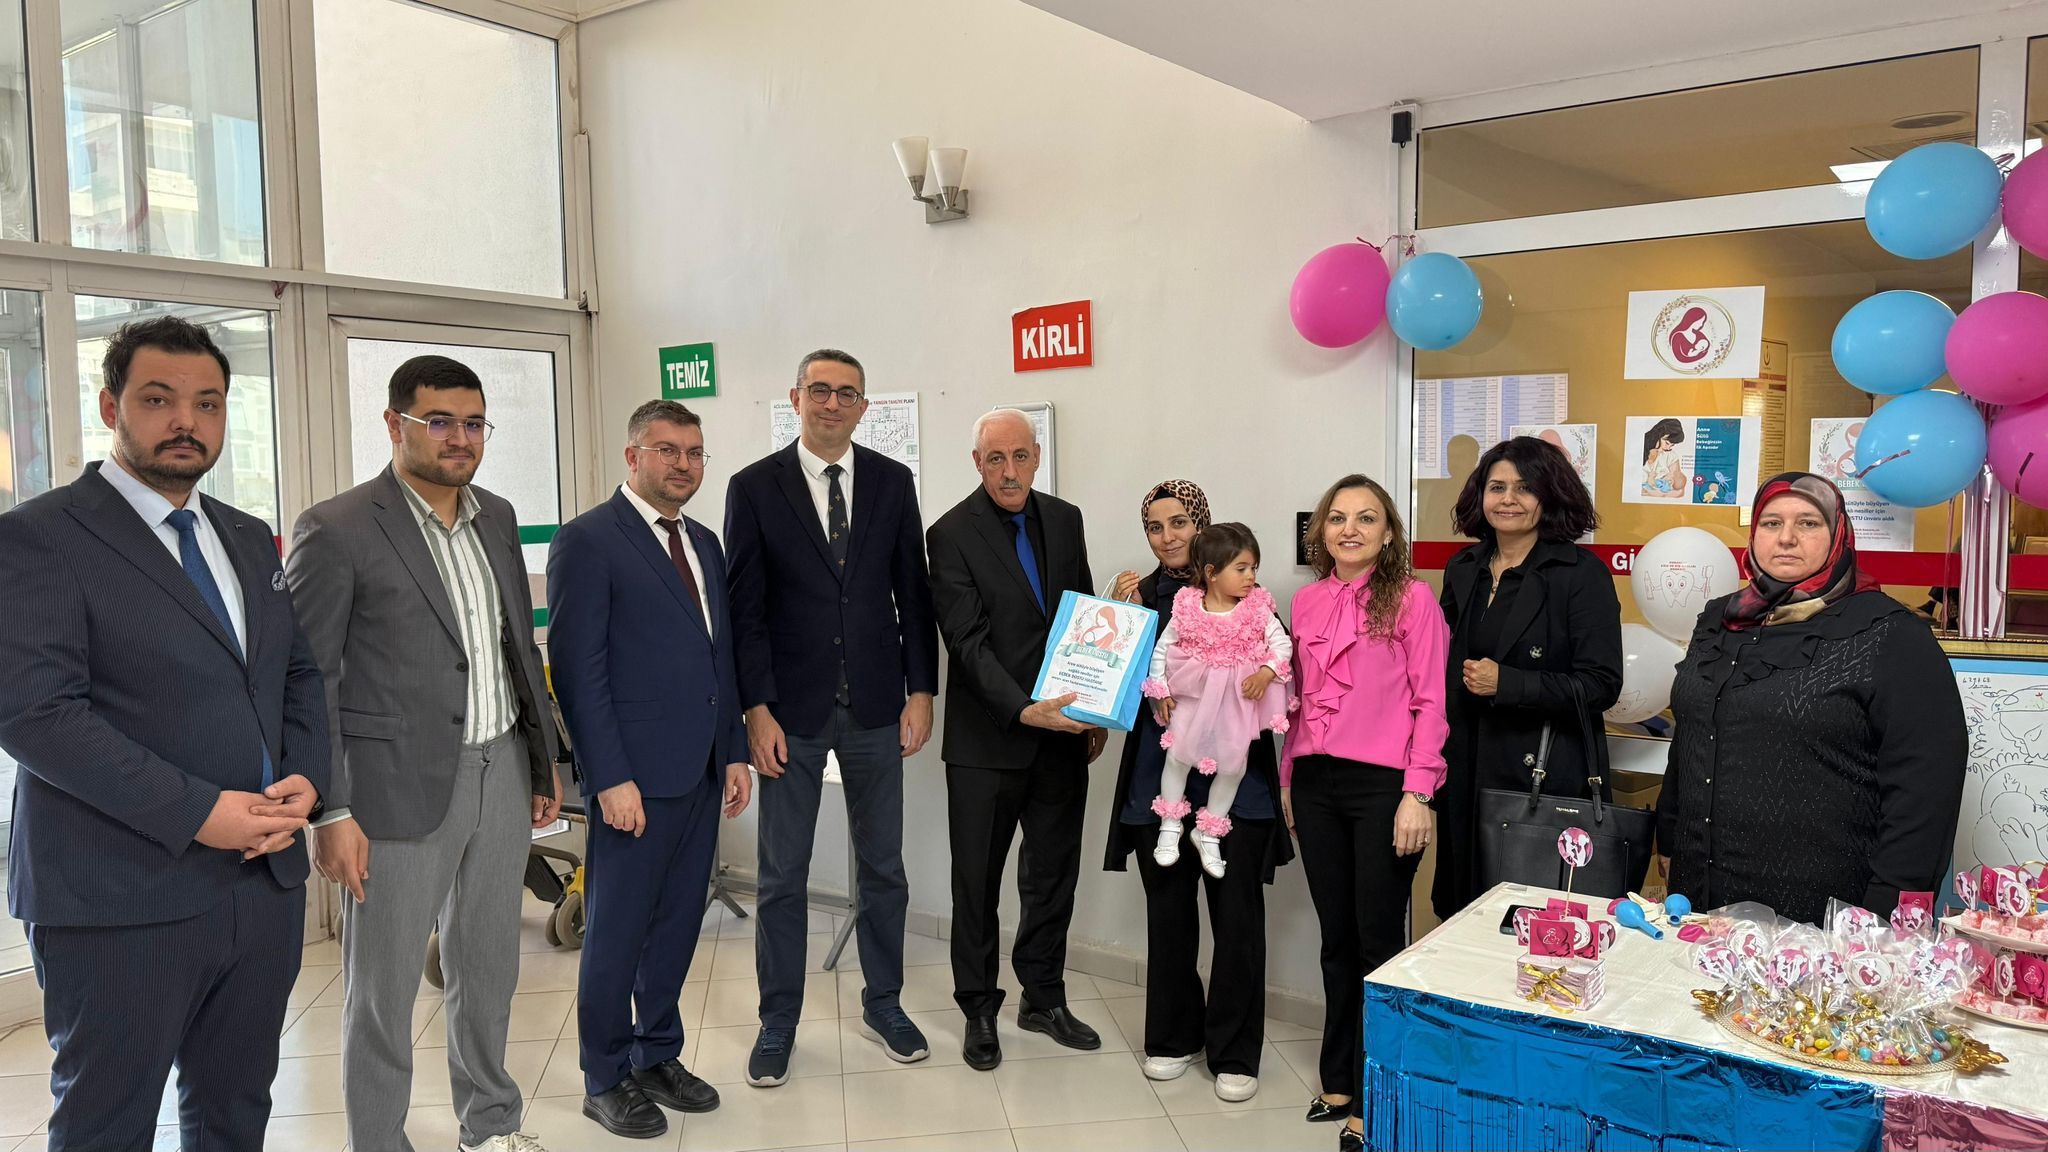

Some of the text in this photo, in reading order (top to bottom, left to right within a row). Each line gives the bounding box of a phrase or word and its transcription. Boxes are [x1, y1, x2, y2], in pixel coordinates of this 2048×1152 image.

[1022, 314, 1084, 359] KİRLİ
[666, 354, 710, 389] TEMİZ
[1837, 480, 1860, 488] BEBEK
